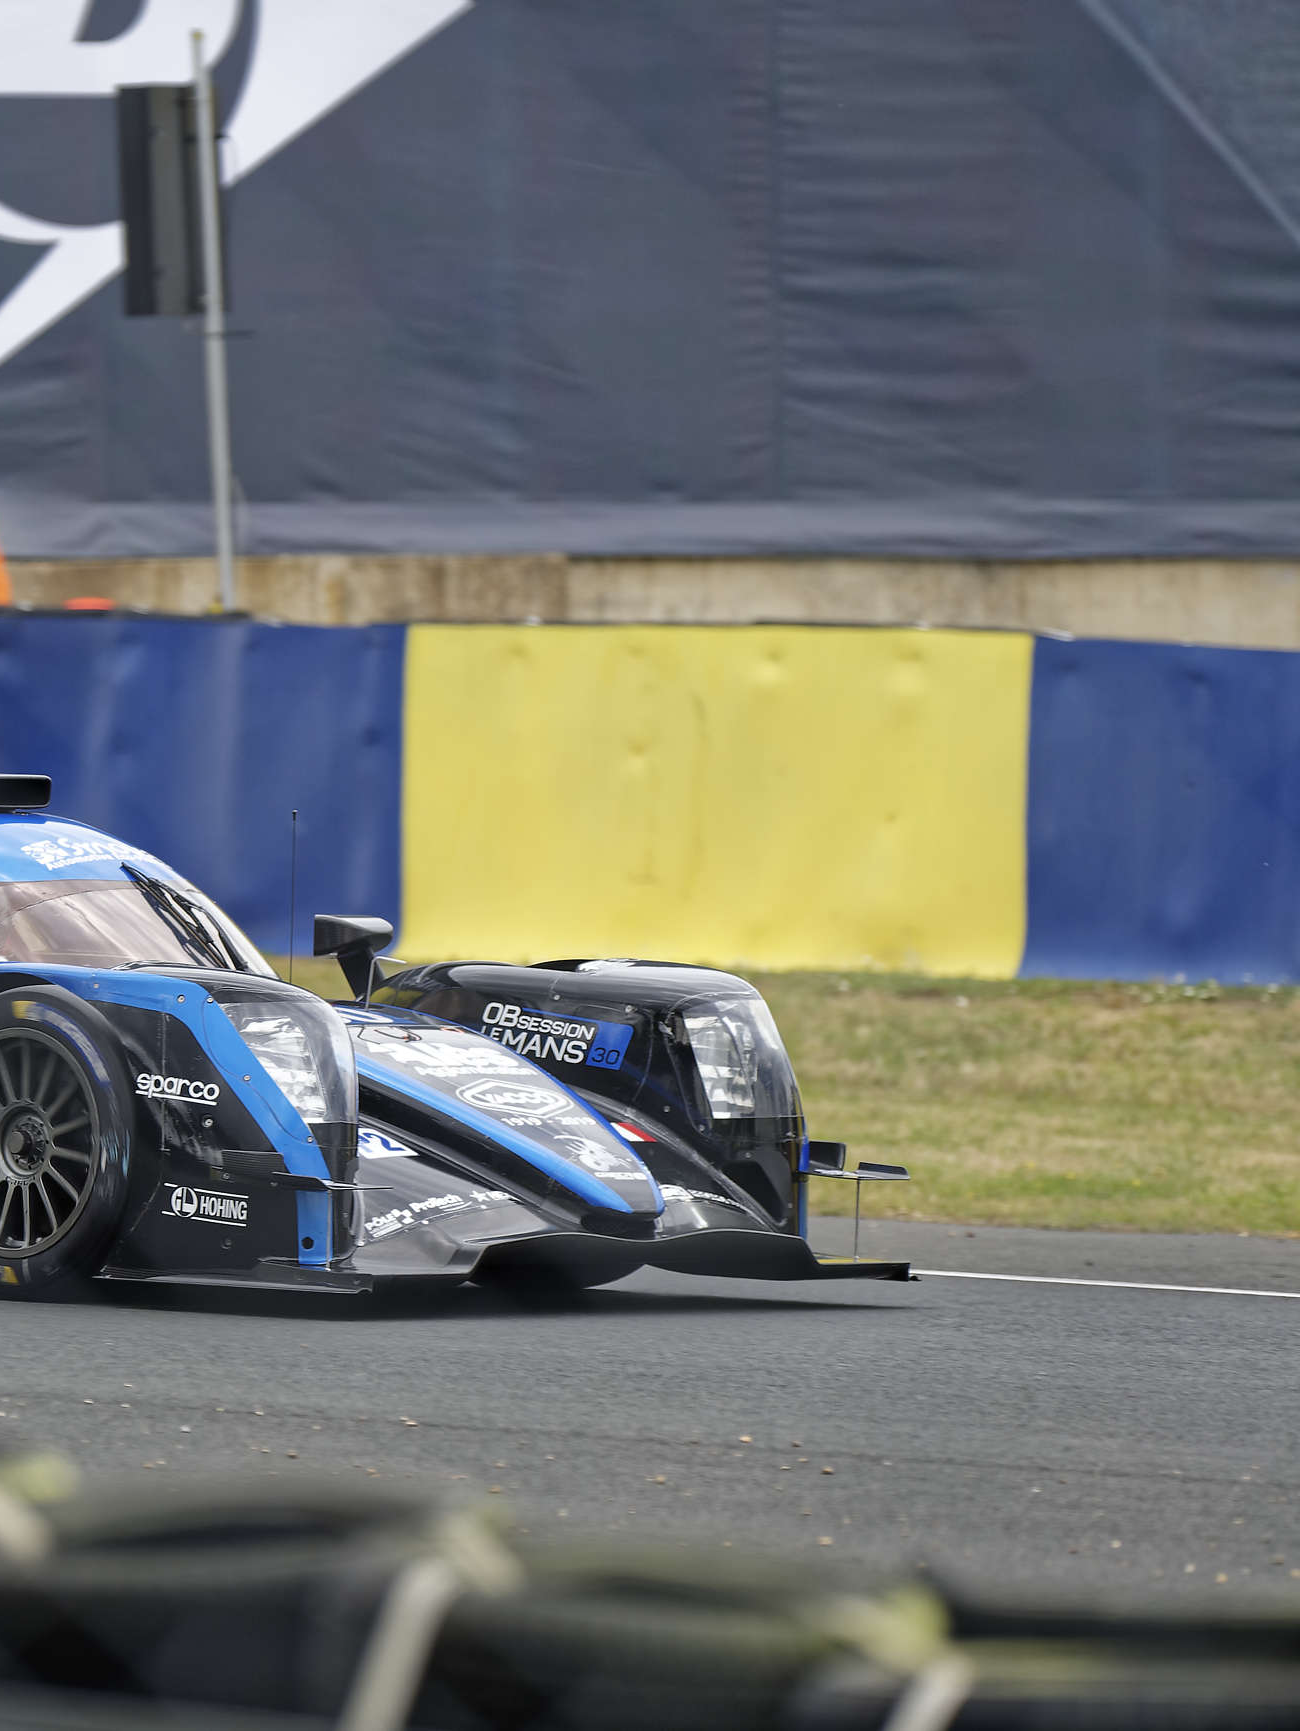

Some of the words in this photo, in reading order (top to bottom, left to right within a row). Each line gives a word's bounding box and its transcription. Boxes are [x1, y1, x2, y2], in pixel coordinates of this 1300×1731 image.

[501, 1028, 588, 1065] MANS
[591, 1047, 621, 1066] 30
[135, 1072, 221, 1100] sparco
